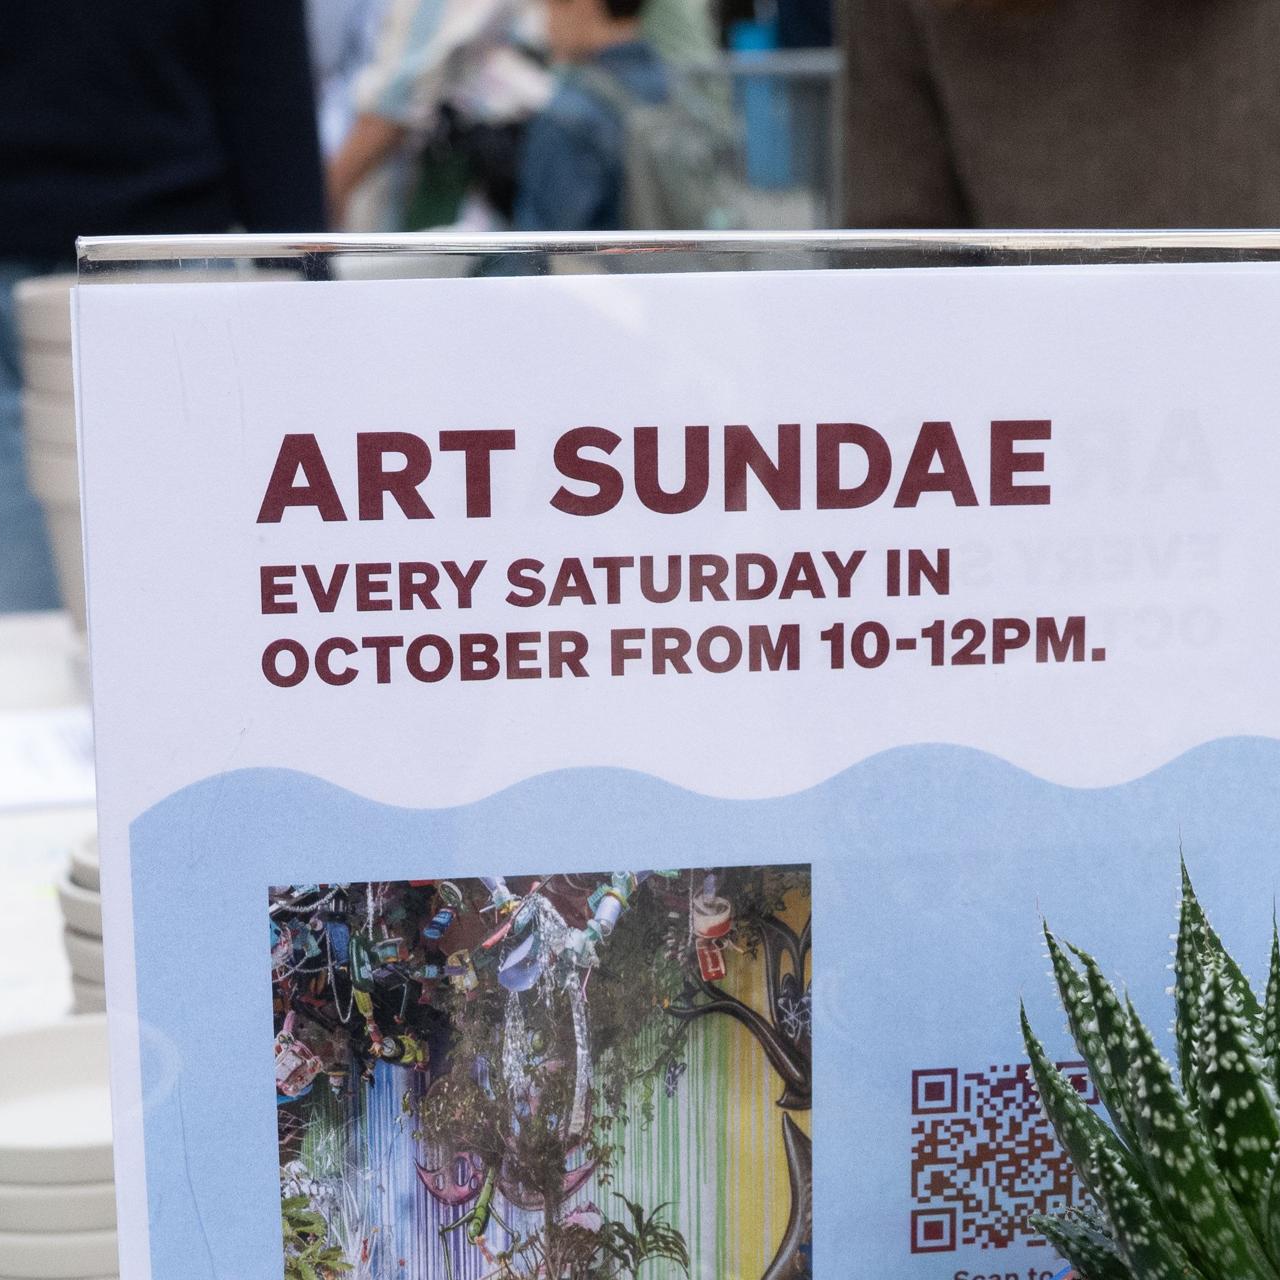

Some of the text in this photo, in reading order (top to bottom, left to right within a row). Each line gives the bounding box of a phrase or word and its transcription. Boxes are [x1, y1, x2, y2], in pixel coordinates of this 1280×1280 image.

[256, 420, 1052, 523] ART SUNDAE
[260, 560, 488, 614] EVERY
[506, 551, 867, 607] SATURDAY
[887, 549, 950, 596] IN
[261, 631, 590, 688] OCTOBER
[611, 624, 801, 676] FROM
[821, 616, 1106, 669] 10-12PM.
